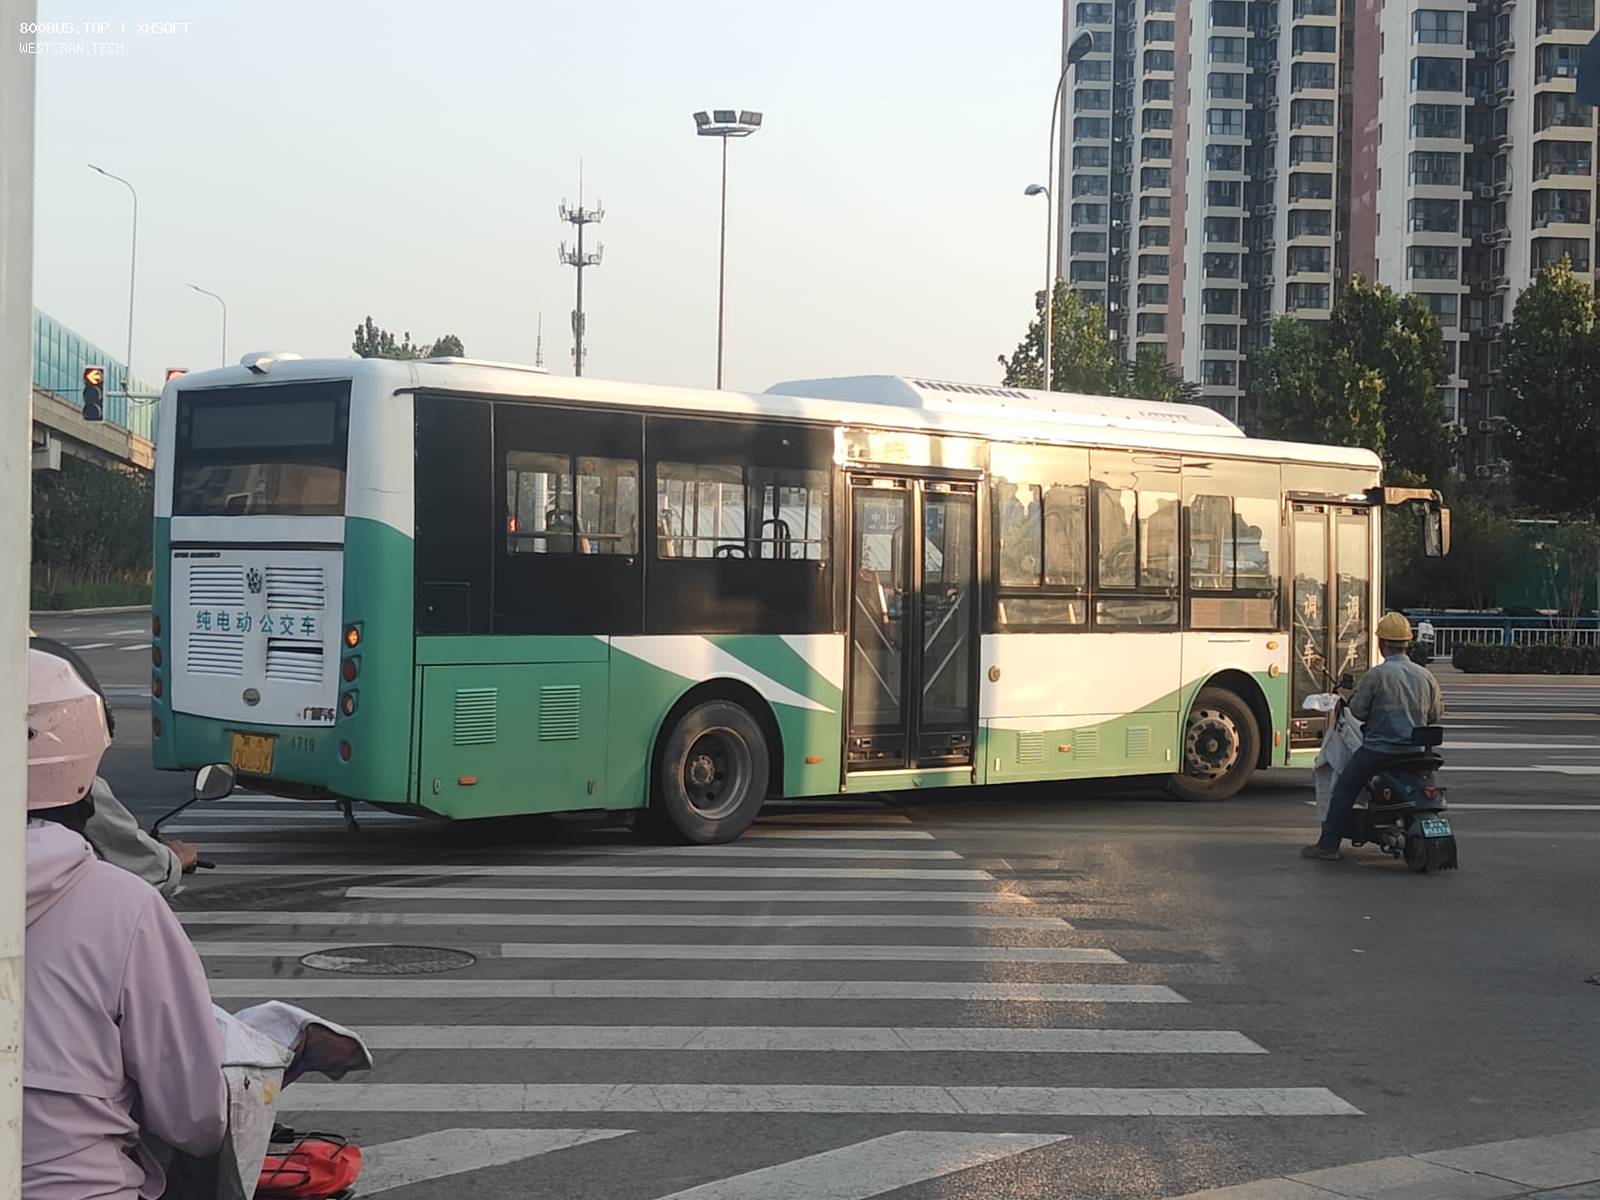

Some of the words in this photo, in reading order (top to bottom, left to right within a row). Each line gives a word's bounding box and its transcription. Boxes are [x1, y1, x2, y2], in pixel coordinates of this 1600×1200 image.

[196, 610, 316, 637] 纯电动公交车
[291, 737, 316, 753] 1719
